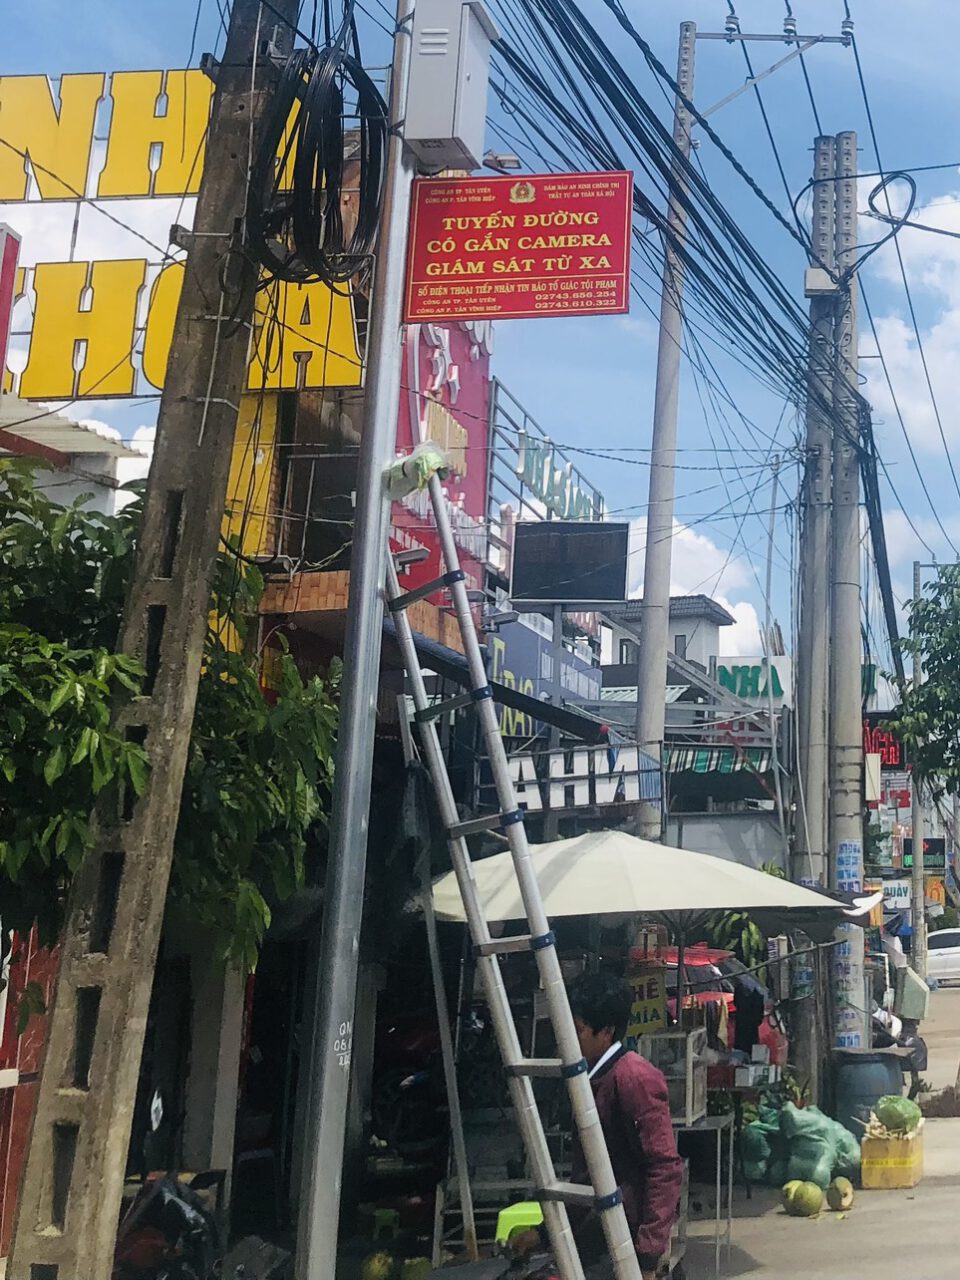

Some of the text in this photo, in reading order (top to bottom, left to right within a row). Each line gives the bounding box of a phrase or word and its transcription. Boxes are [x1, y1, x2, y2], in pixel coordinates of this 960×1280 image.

[442, 210, 600, 230] TUYẾN ĐƯỜNG
[426, 232, 612, 253] CÓ GẮN CAMERA
[426, 254, 612, 275] GIÁM SÁT TỪ XA
[417, 279, 617, 297] SỐ ĐIỆN THOẠI TIẾP NHẬN TIN BÁO TỐ GIÁC TỘI PHẠM
[416, 306, 434, 314] CÔNG
[485, 304, 502, 312] HIỆP
